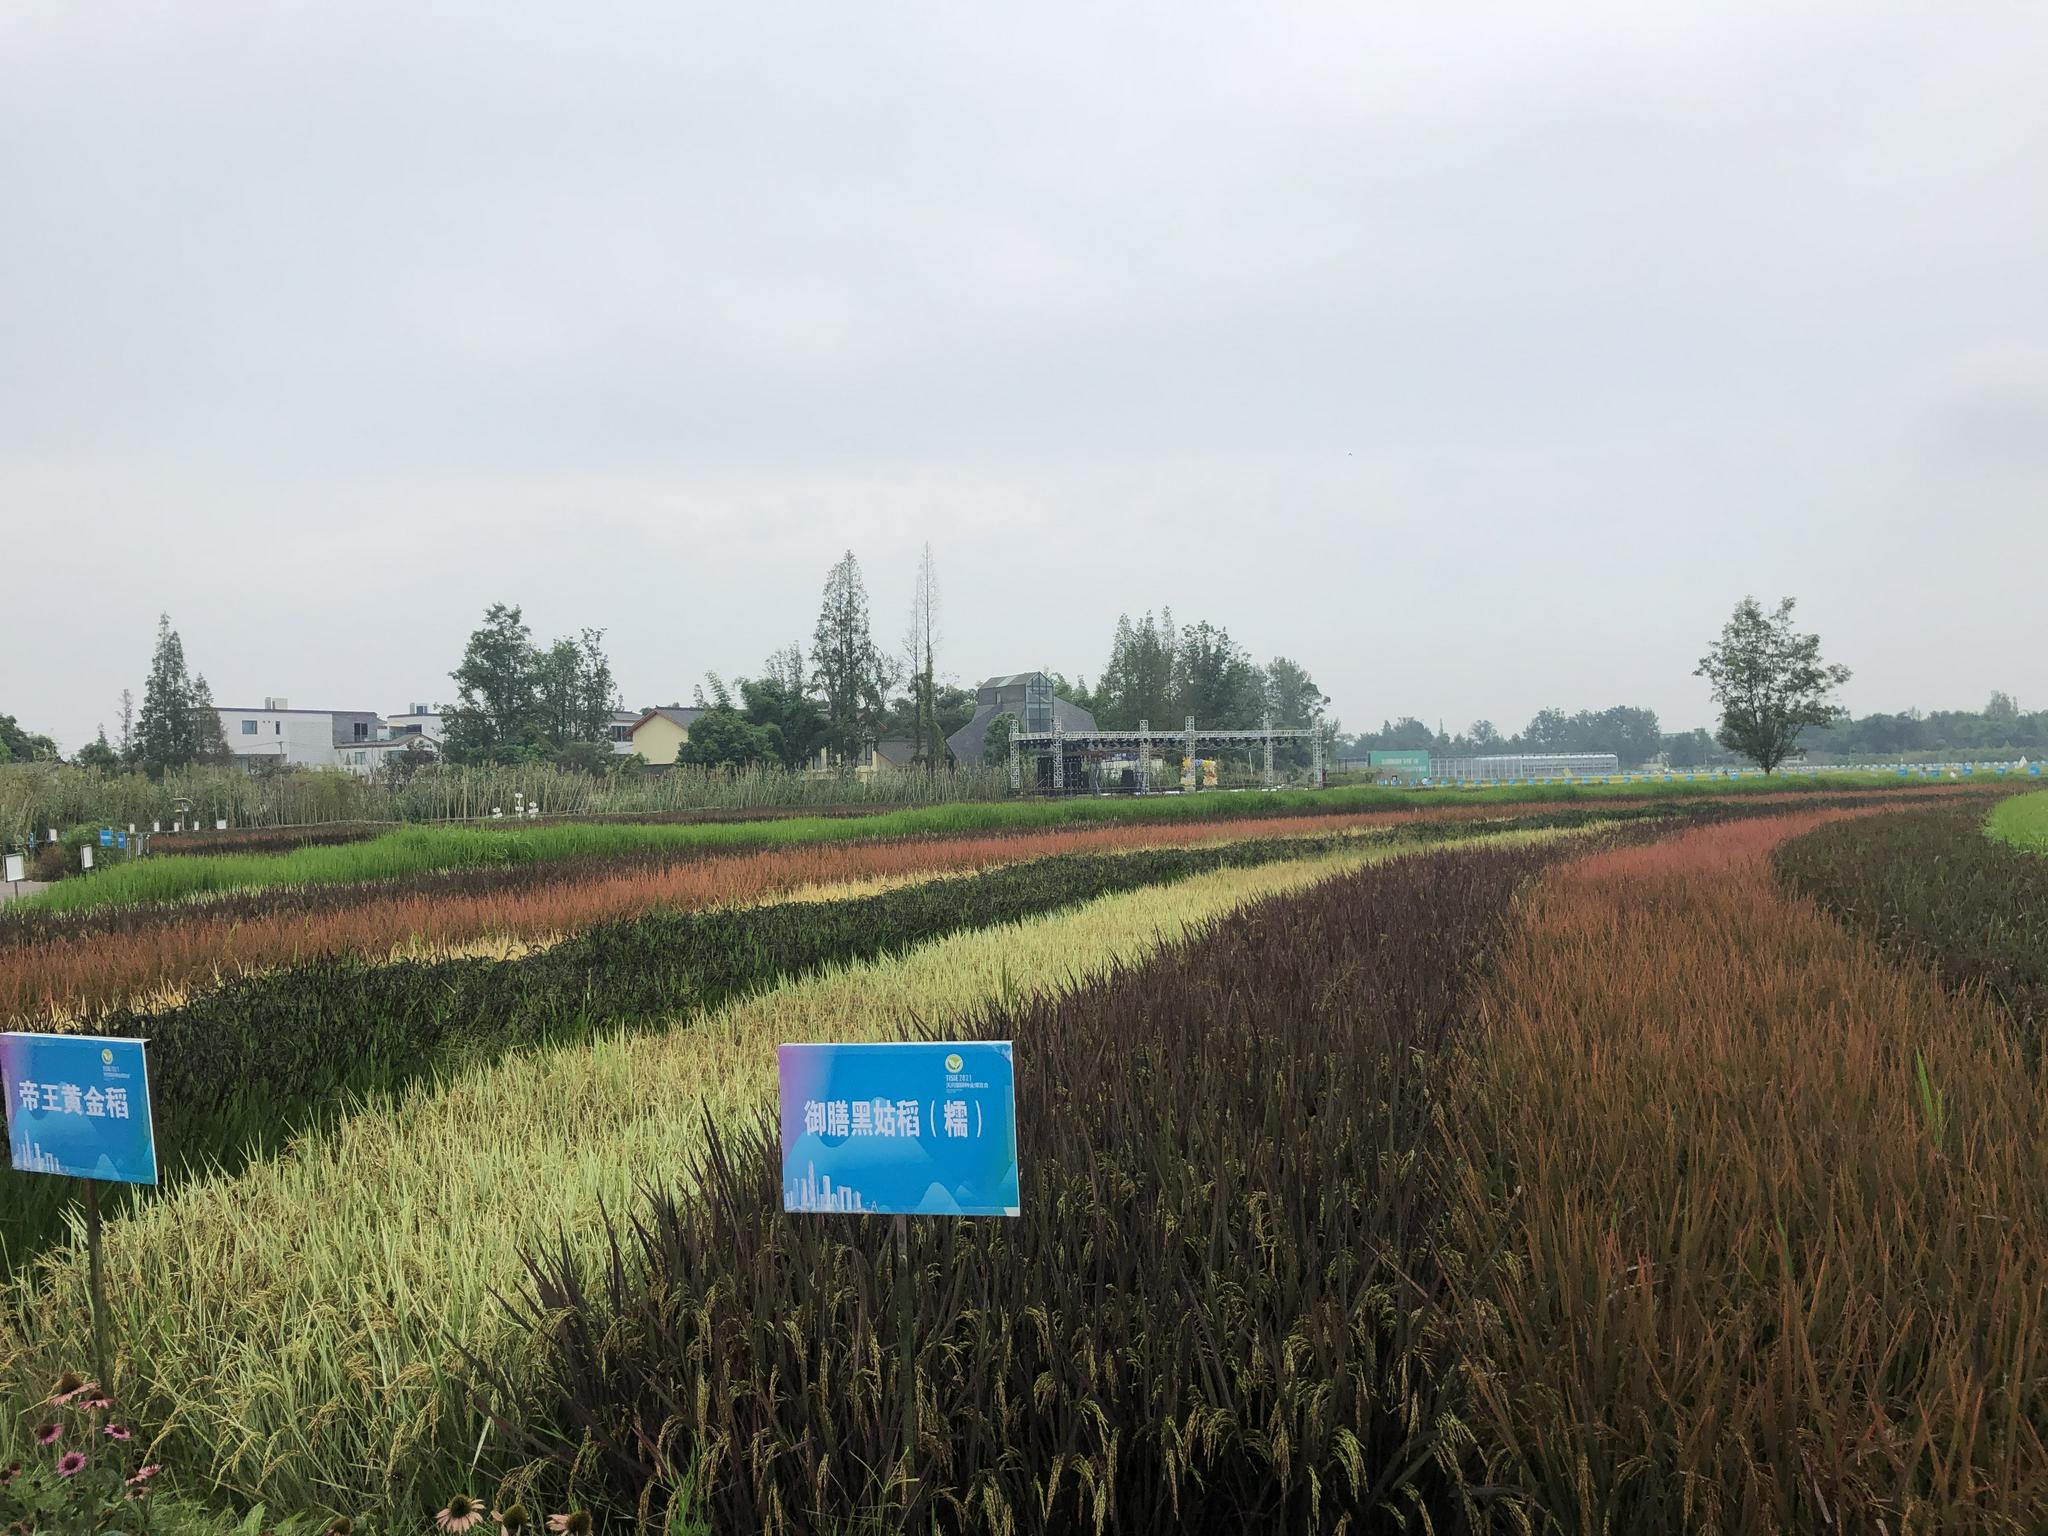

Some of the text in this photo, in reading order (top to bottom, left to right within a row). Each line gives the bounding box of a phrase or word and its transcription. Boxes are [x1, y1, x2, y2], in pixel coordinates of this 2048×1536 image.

[18, 1080, 129, 1119] 帝王黄金稻
